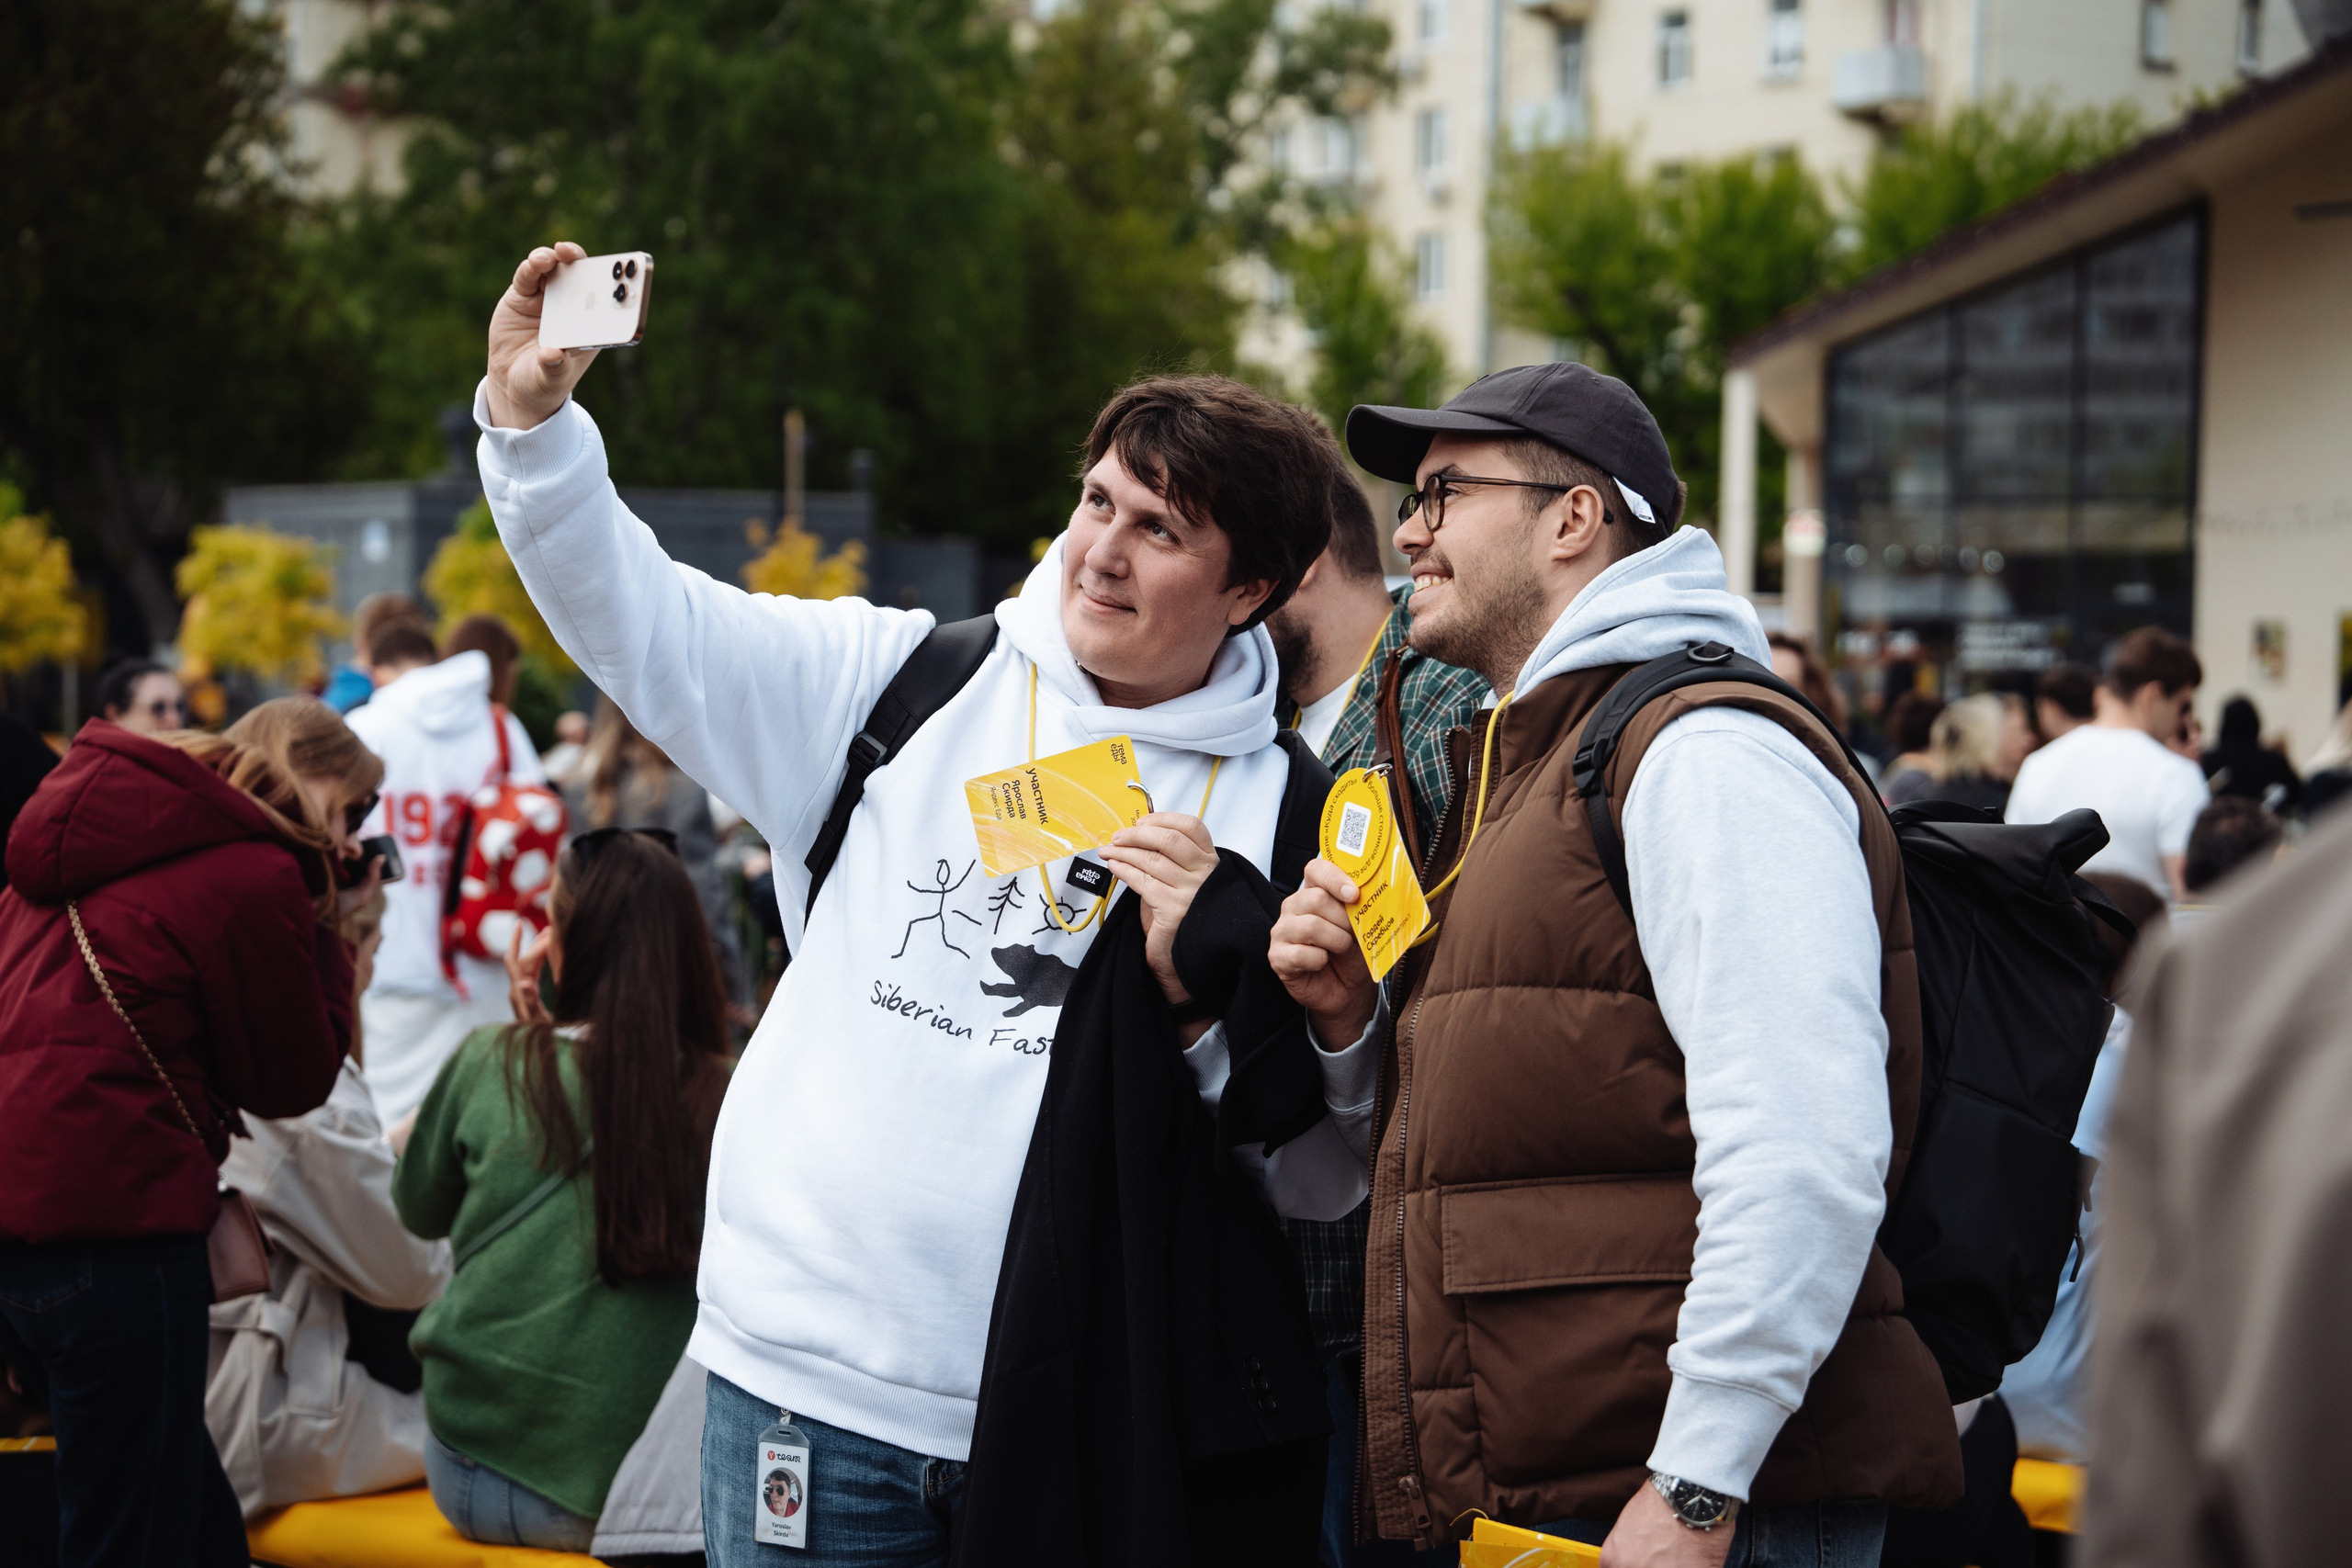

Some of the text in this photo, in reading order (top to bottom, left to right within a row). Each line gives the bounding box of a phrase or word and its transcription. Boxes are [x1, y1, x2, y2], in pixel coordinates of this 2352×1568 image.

[1110, 743, 1120, 761] еды
[1117, 743, 1127, 764] тема
[989, 786, 999, 808] Яндекс
[1002, 783, 1015, 818] Скирда
[1012, 780, 1026, 819] Ярослав
[1025, 767, 1049, 825] участник
[1367, 781, 1384, 813] больше
[1370, 815, 1384, 859] столиков
[1076, 872, 1096, 885] тема
[1082, 868, 1101, 880] еды
[1360, 859, 1371, 874] для
[1354, 879, 1388, 925] участник
[1363, 914, 1385, 942] Гордей
[1366, 917, 1395, 951] Скребцов
[871, 979, 972, 1040] Siberian
[776, 1452, 801, 1463] team
[772, 1521, 791, 1530] Yaroslav
[774, 1529, 789, 1538] Skirda
